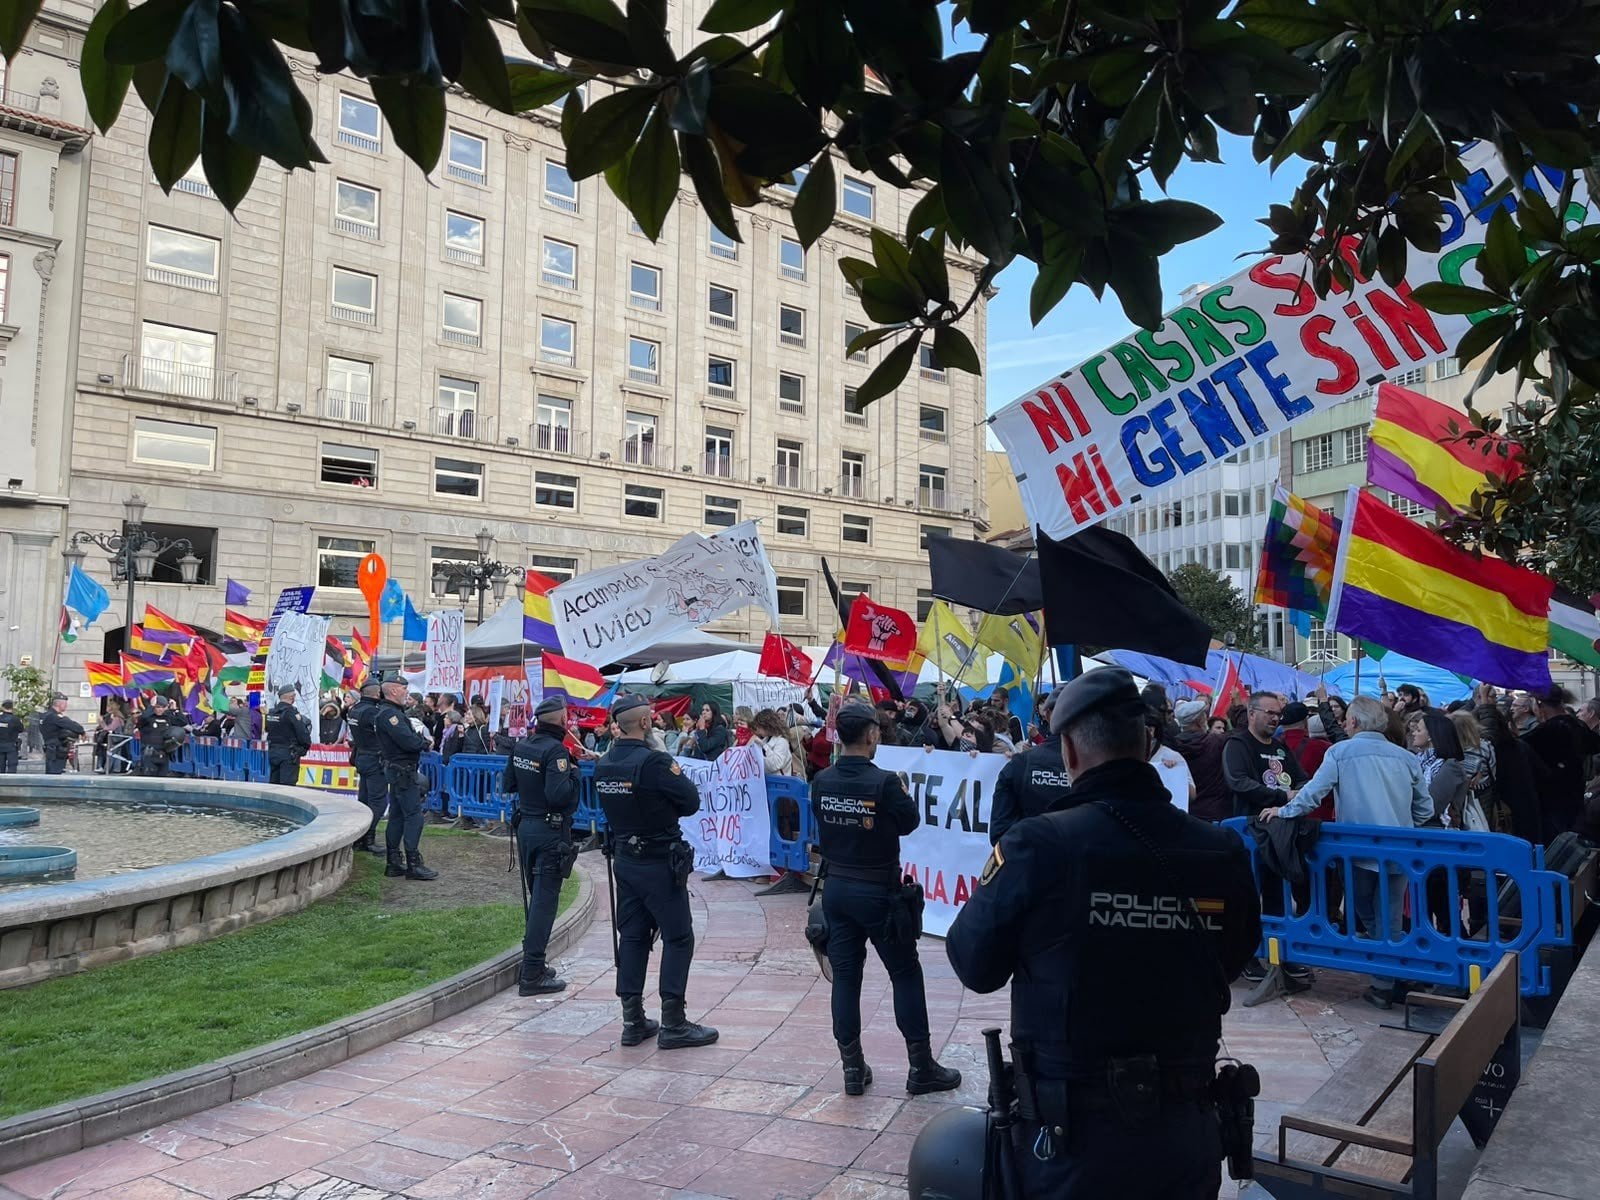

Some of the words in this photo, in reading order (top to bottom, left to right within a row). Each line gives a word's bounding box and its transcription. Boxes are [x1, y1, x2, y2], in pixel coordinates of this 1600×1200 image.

[1079, 285, 1267, 415] CASAS
[1119, 341, 1315, 487] GENTE
[1032, 770, 1069, 780] POLIC
[1032, 778, 1072, 788] NACIO
[821, 796, 864, 807] POLICIA
[821, 803, 876, 815] NACIONAL
[945, 778, 989, 834] AL
[925, 866, 949, 905] LA
